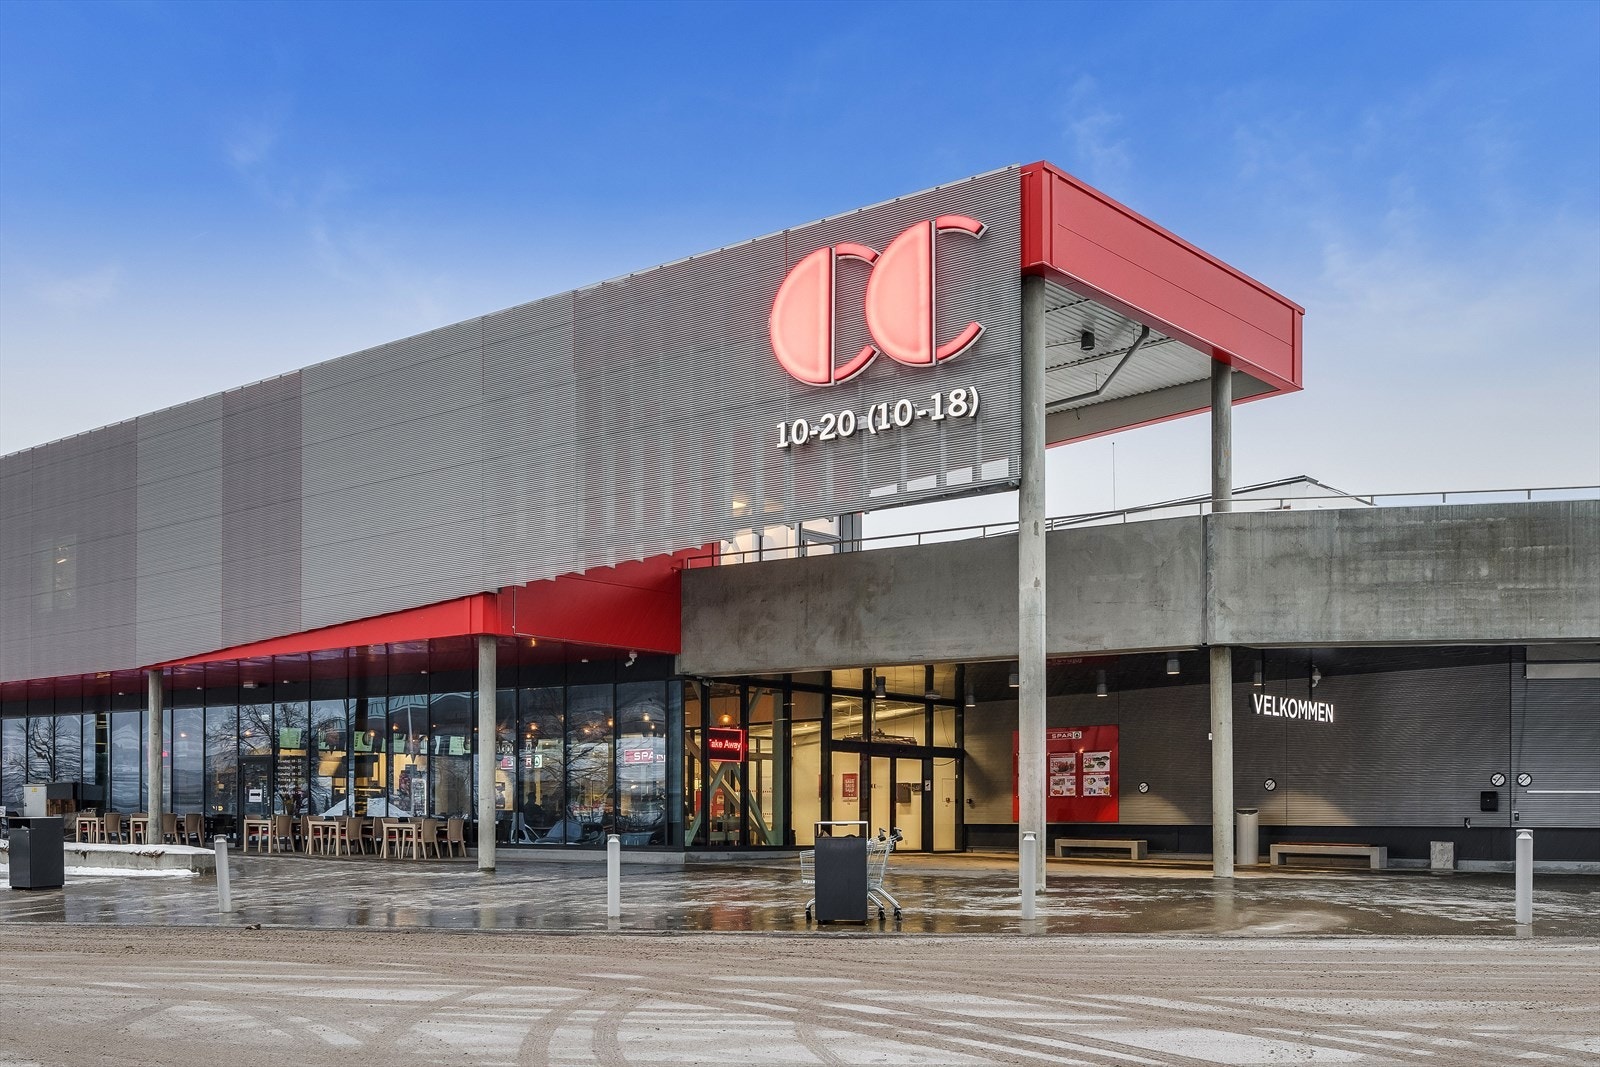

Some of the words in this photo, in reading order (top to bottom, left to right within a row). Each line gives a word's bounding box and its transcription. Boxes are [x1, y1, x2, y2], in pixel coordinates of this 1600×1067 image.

[776, 410, 858, 449] 10-20
[867, 386, 980, 435] (10-18)
[1253, 693, 1334, 723] VELKOMMEN
[723, 739, 742, 751] Away
